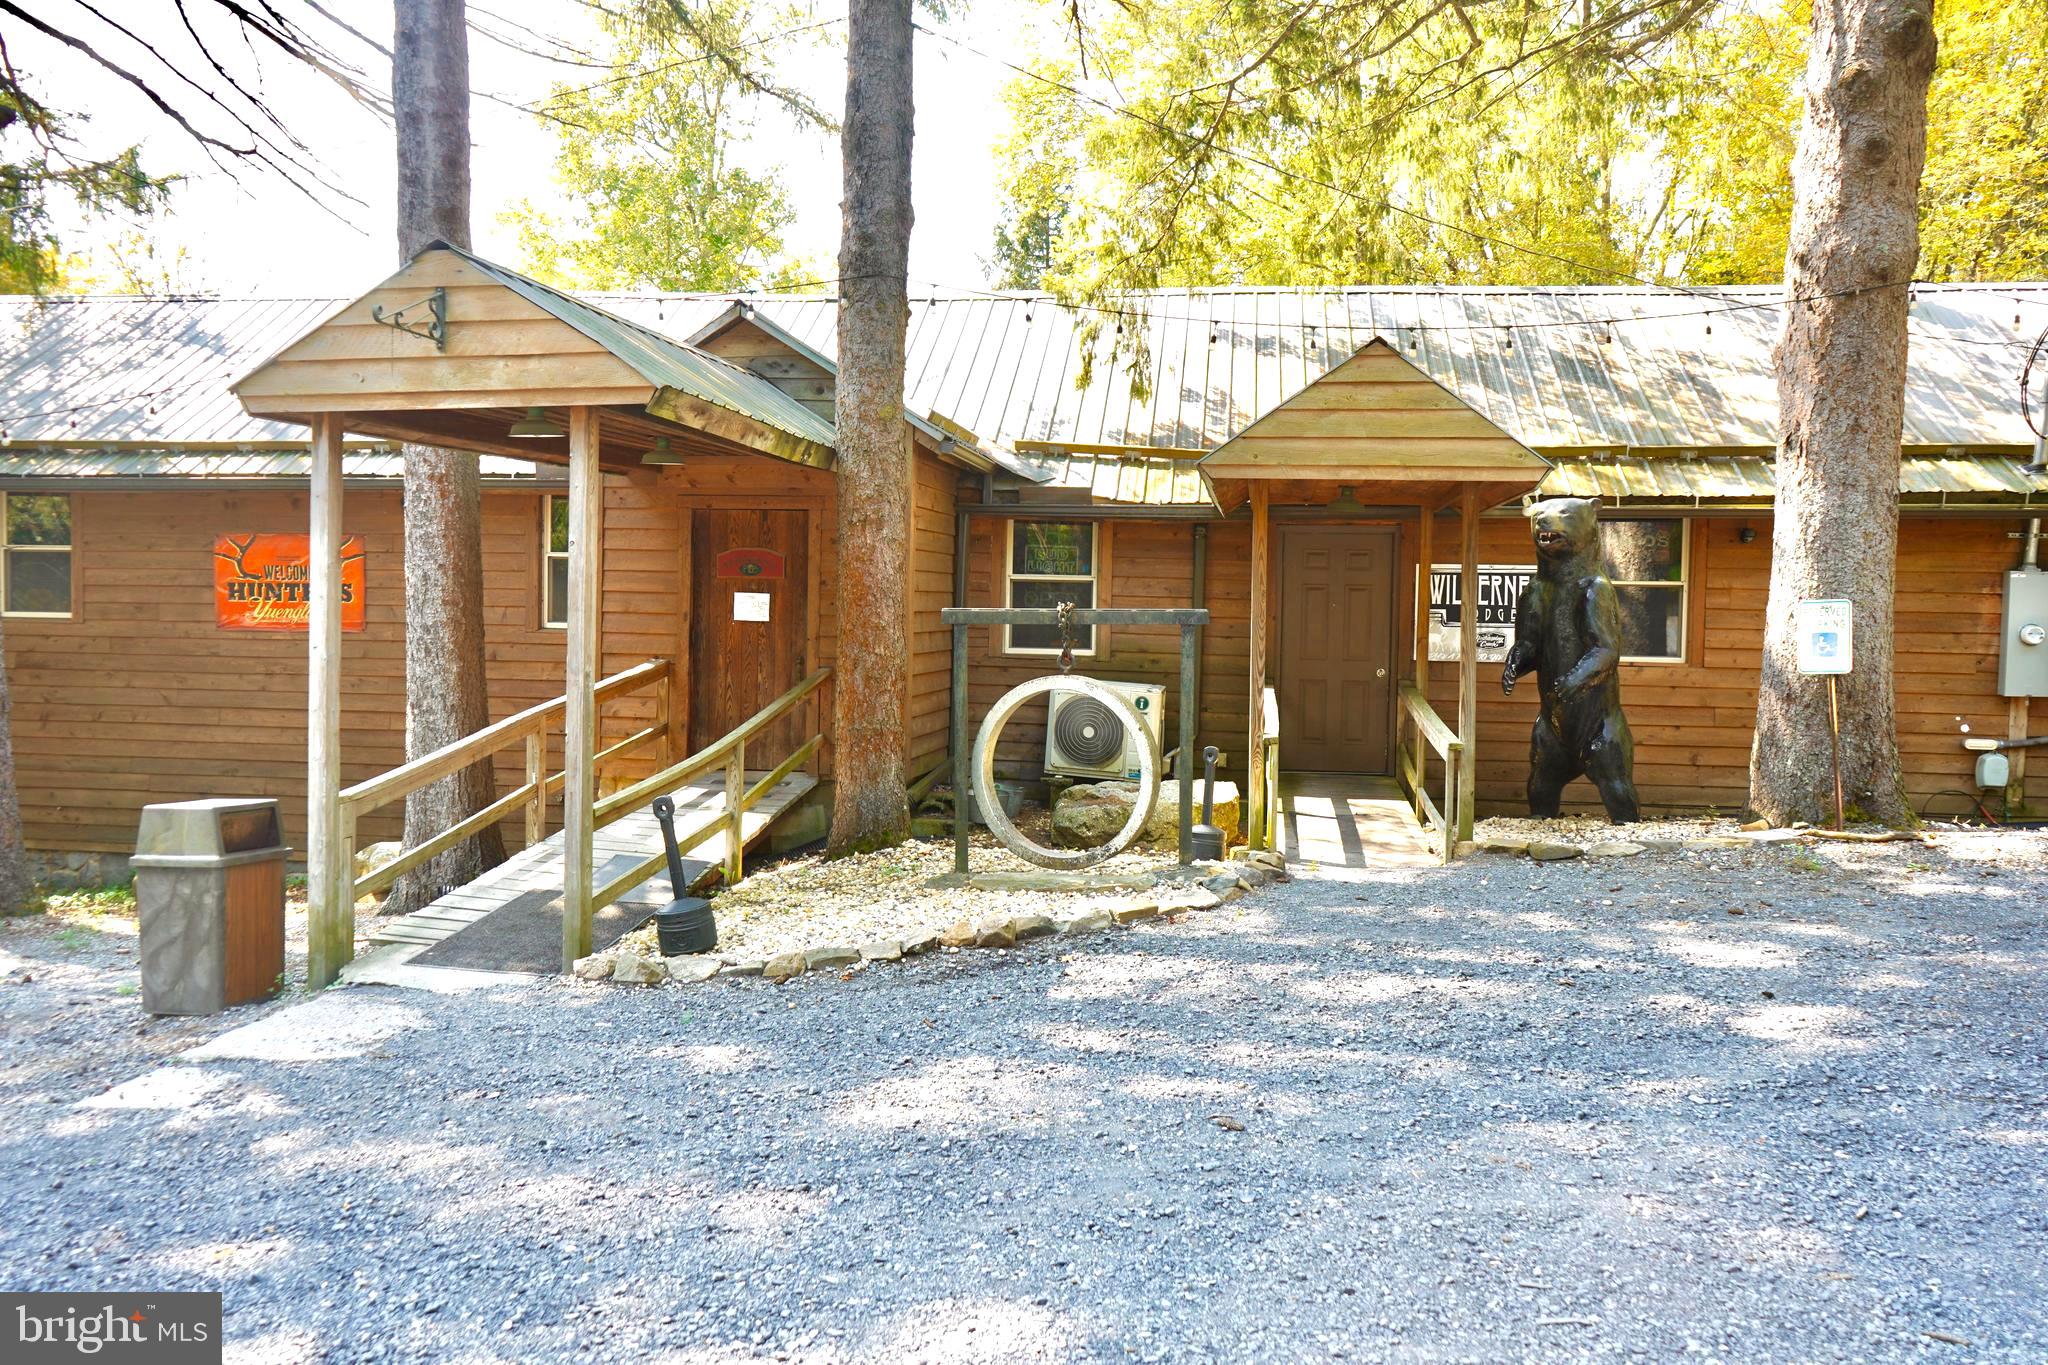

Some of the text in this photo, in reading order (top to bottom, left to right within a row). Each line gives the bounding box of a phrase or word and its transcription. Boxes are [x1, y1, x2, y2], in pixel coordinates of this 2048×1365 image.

[263, 564, 311, 582] WELCOM
[1028, 560, 1076, 574] LIGHT
[226, 582, 354, 603] HUNTS
[1430, 574, 1531, 608] WILERNE
[247, 596, 311, 624] Yuengl
